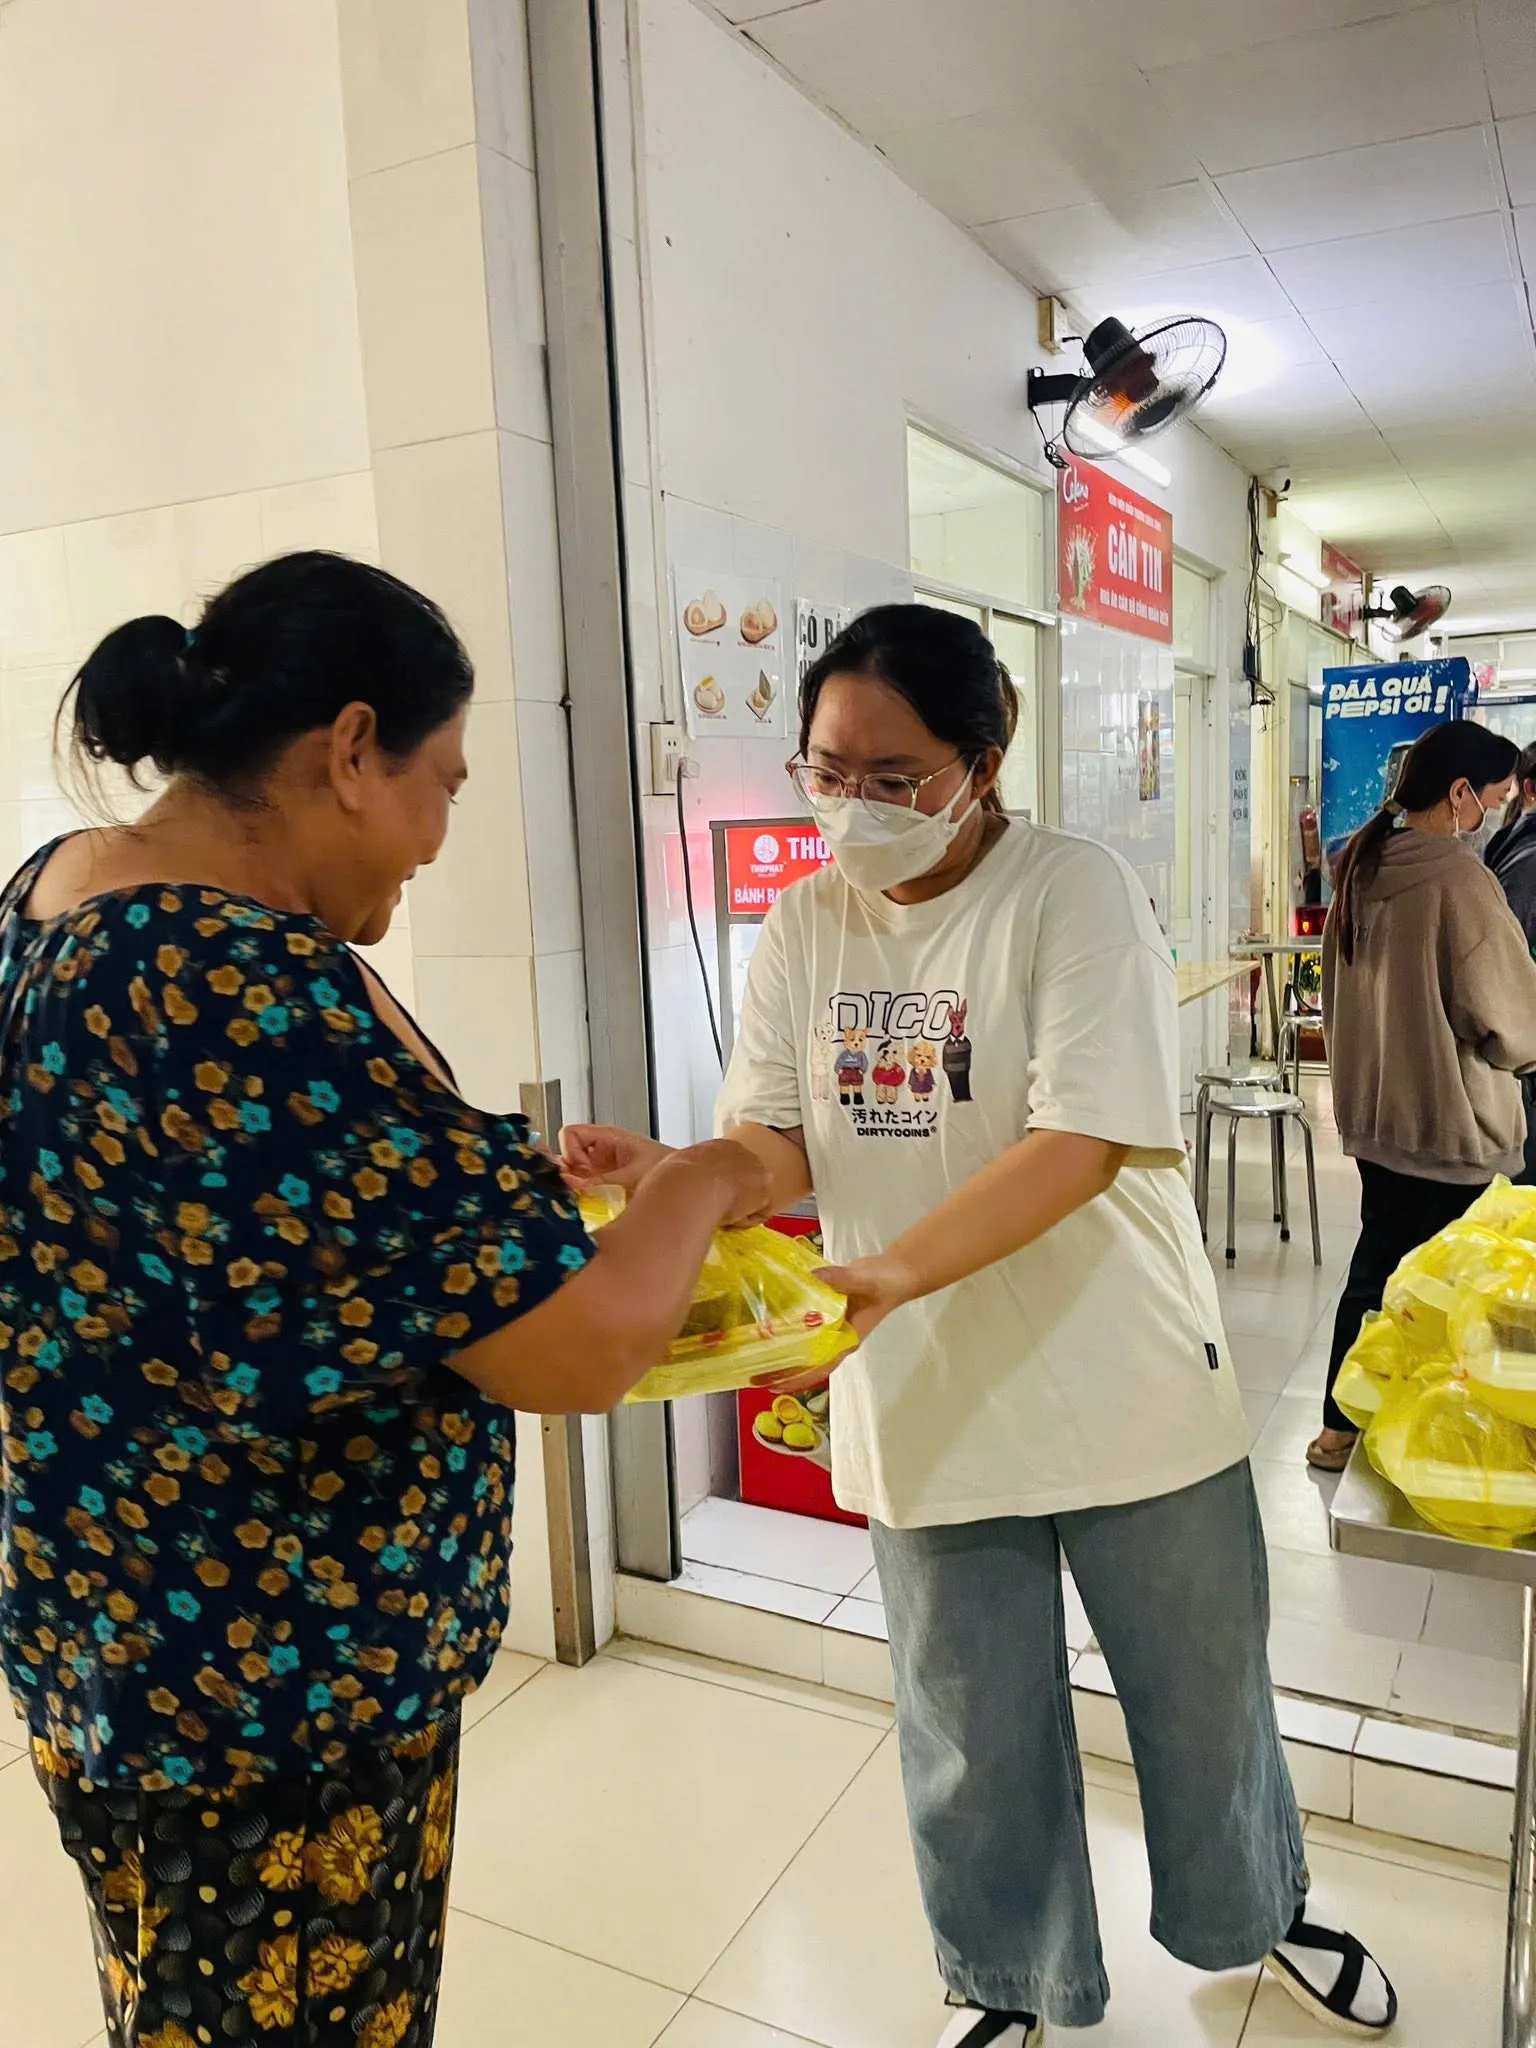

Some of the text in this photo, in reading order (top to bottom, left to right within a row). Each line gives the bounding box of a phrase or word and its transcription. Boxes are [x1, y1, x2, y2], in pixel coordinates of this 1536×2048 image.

[1108, 520, 1163, 593] CĂN TIN
[1325, 697, 1401, 719] PEPSI
[734, 884, 765, 904] BÁNH
[829, 990, 959, 1043] DICO
[852, 1108, 938, 1124] 汚れたコイン
